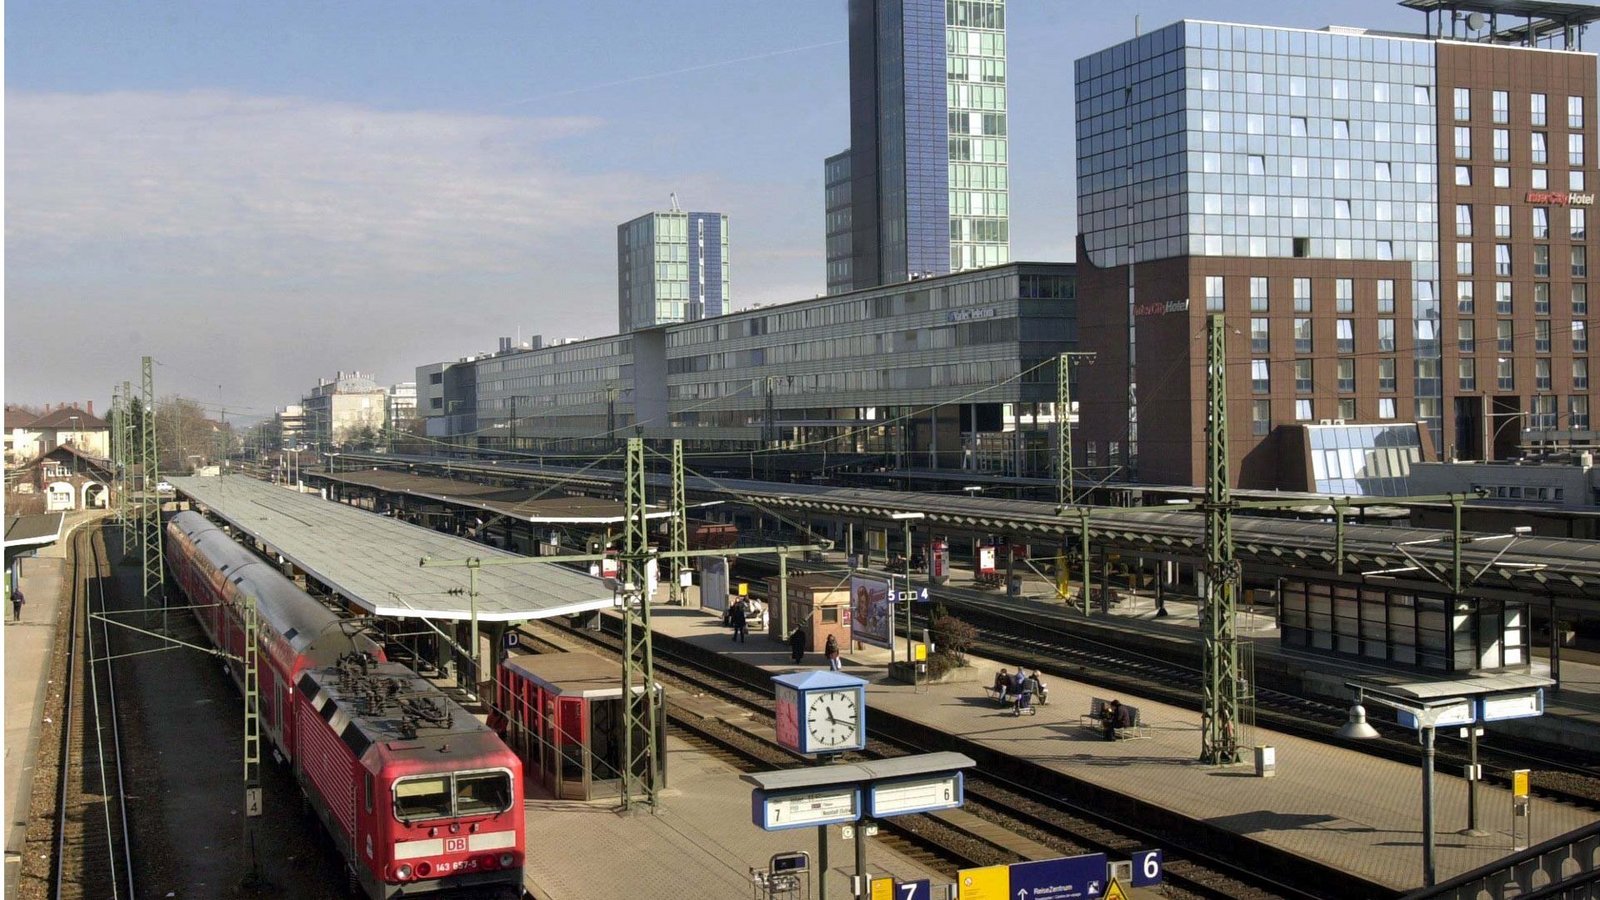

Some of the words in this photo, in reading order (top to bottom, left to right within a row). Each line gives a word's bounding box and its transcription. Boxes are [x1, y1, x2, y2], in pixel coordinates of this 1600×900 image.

[888, 590, 895, 601] 5
[921, 588, 928, 599] 4
[509, 633, 518, 646] D
[944, 789, 950, 801] 6
[251, 803, 258, 812] 4
[775, 809, 780, 822] 7
[448, 839, 465, 851] DB
[436, 863, 450, 872] 143
[452, 860, 477, 870] 657-5
[1143, 852, 1159, 878] 6
[901, 883, 917, 900] 7
